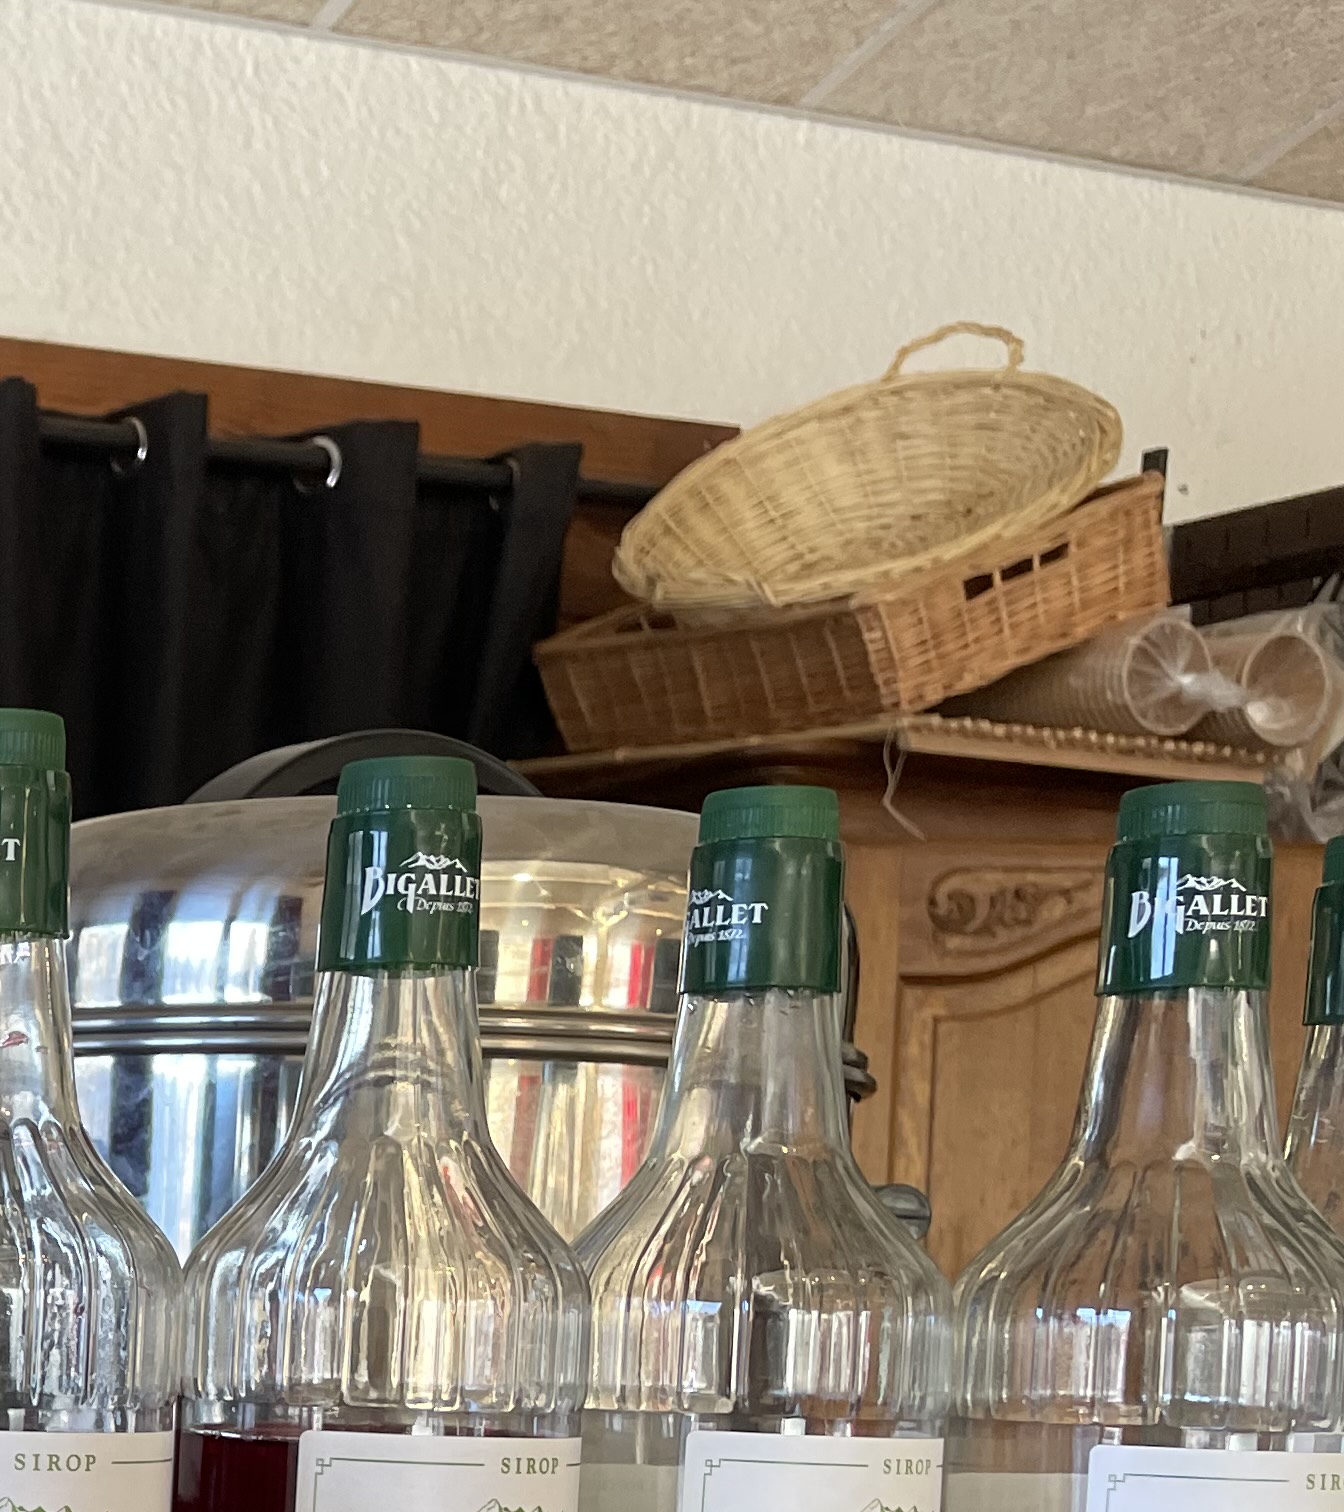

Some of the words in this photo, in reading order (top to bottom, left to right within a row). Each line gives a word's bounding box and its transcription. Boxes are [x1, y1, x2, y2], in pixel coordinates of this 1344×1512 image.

[688, 902, 769, 930] ALLET
[14, 1453, 98, 1472] SIROP
[500, 1457, 560, 1475] SIROP
[883, 1458, 932, 1476] SIROP
[1305, 1473, 1344, 1492] SIR
